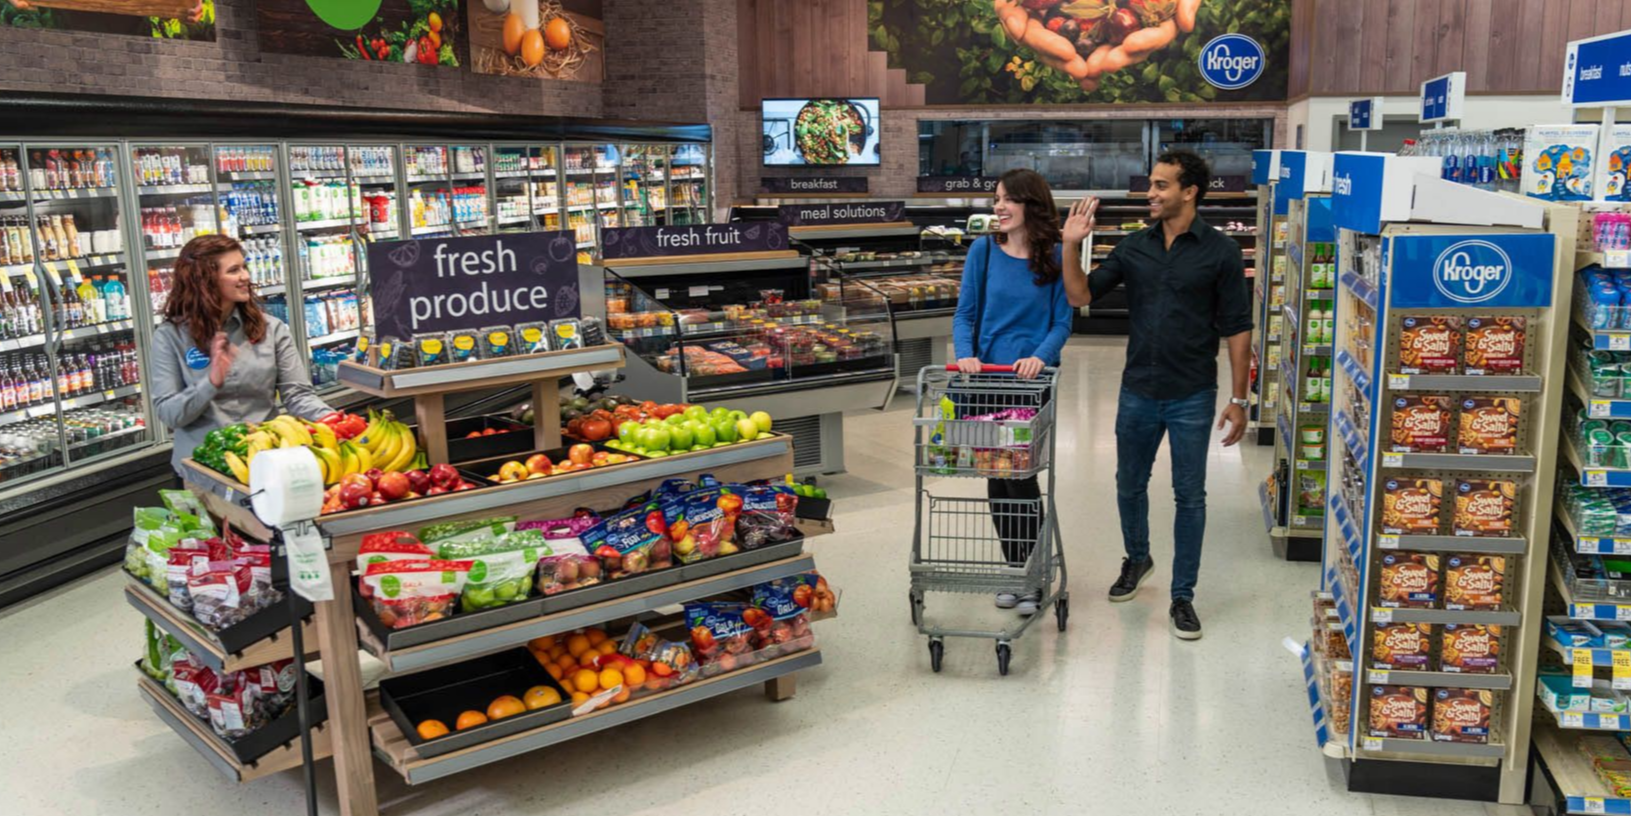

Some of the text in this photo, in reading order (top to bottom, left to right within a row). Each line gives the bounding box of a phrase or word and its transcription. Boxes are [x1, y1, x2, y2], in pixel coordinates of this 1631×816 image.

[1206, 43, 1259, 82] Kroger
[1580, 65, 1603, 81] breakfast
[790, 179, 838, 189] breakfast
[945, 178, 970, 191] grab
[972, 177, 981, 188] &
[800, 204, 886, 220] meal solutions
[656, 226, 741, 247] fresh fruit
[433, 240, 517, 278] fresh
[1443, 251, 1504, 294] Kroger
[409, 281, 548, 330] produce
[1419, 329, 1449, 341] Sweet
[1484, 329, 1514, 341] Sweet
[1413, 337, 1422, 348] &
[1422, 340, 1449, 355] Salty
[1478, 337, 1515, 355] & Salty
[1411, 409, 1440, 421] Sweet
[1478, 410, 1508, 422] Sweet
[1404, 417, 1440, 434] & Salty
[1471, 418, 1508, 436] & Salty
[1401, 491, 1431, 503] Sweet
[1474, 494, 1504, 505] Sweet
[1395, 499, 1431, 516] & Salty
[1467, 501, 1504, 518] & Salty
[1398, 566, 1428, 577] Sweet
[1464, 568, 1493, 580] Sweet
[1392, 574, 1428, 590] & Salty
[1457, 575, 1493, 592] & Salty
[1391, 629, 1420, 640] Sweet
[1460, 631, 1489, 643] Sweet
[1385, 636, 1420, 653] & Salty
[1454, 639, 1489, 655] & Salty
[1388, 697, 1416, 708] Sweet
[1452, 700, 1481, 712] Sweet
[1381, 704, 1416, 721] & Salty
[1446, 708, 1481, 725] & Salty
